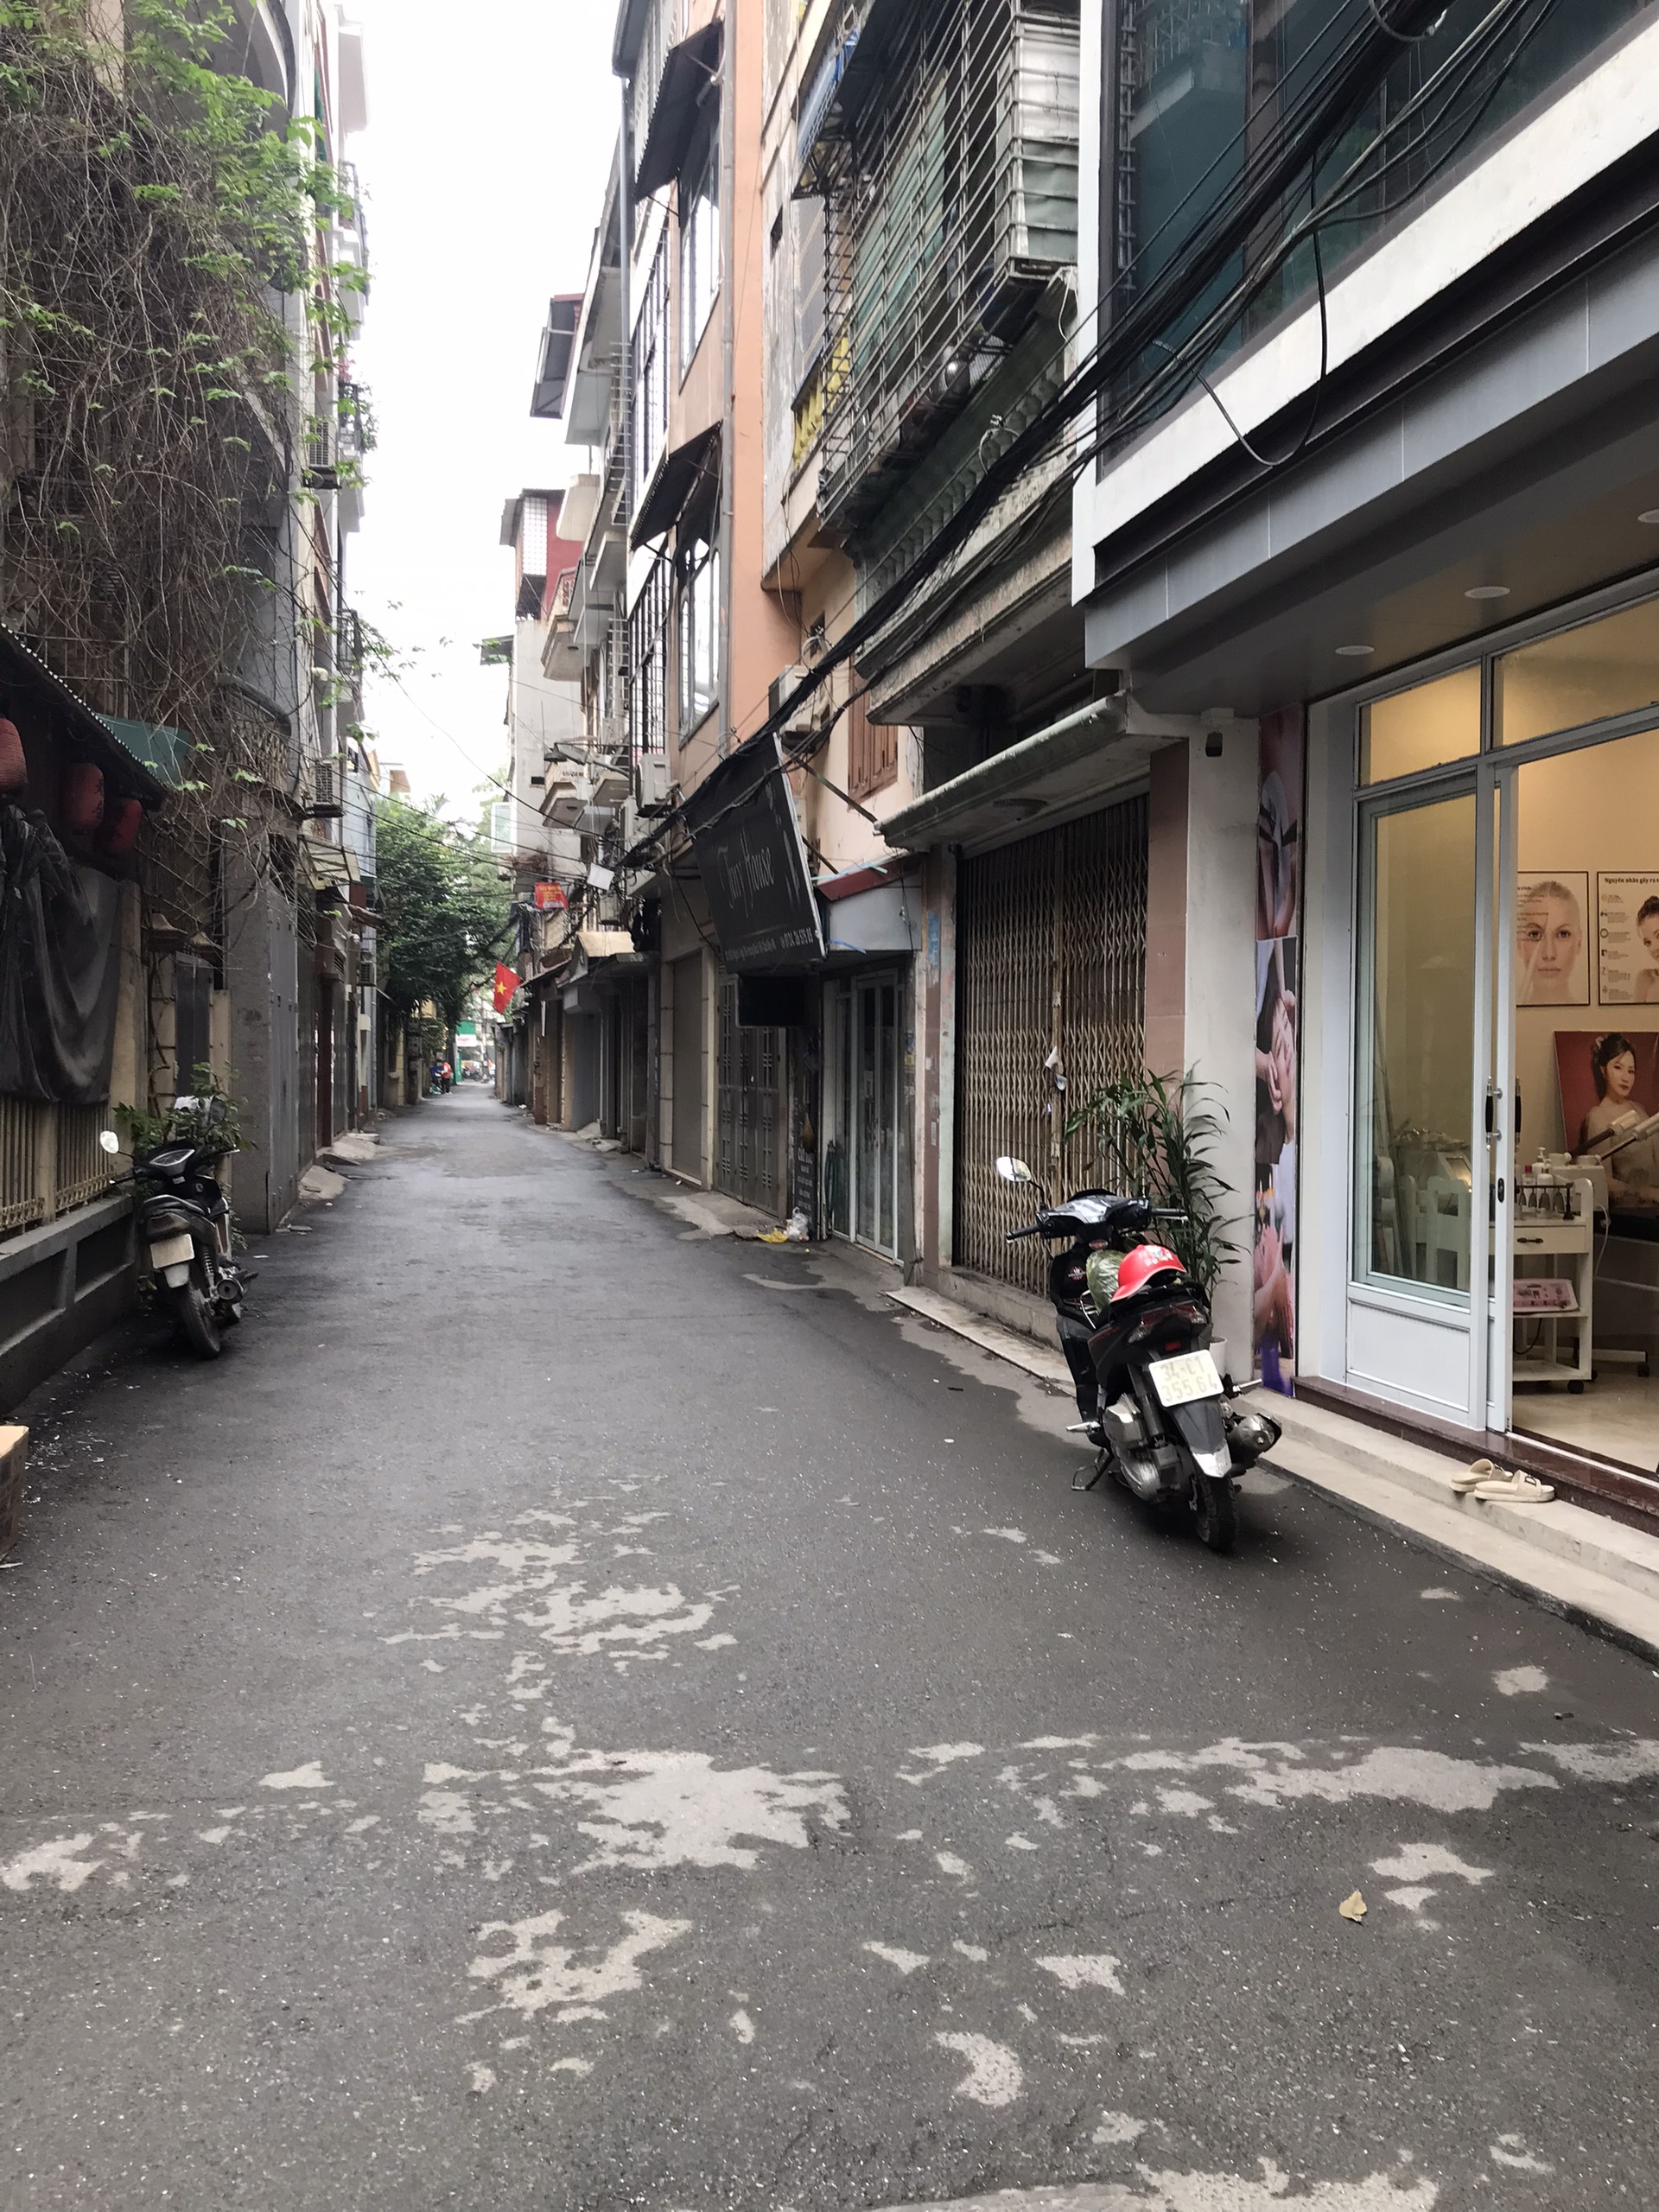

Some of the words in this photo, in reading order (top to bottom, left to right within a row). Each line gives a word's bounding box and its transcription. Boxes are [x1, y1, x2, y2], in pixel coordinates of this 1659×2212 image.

[740, 825, 775, 910] House
[1160, 1356, 1205, 1381] 34-C1
[1161, 1374, 1217, 1402] 355.64
